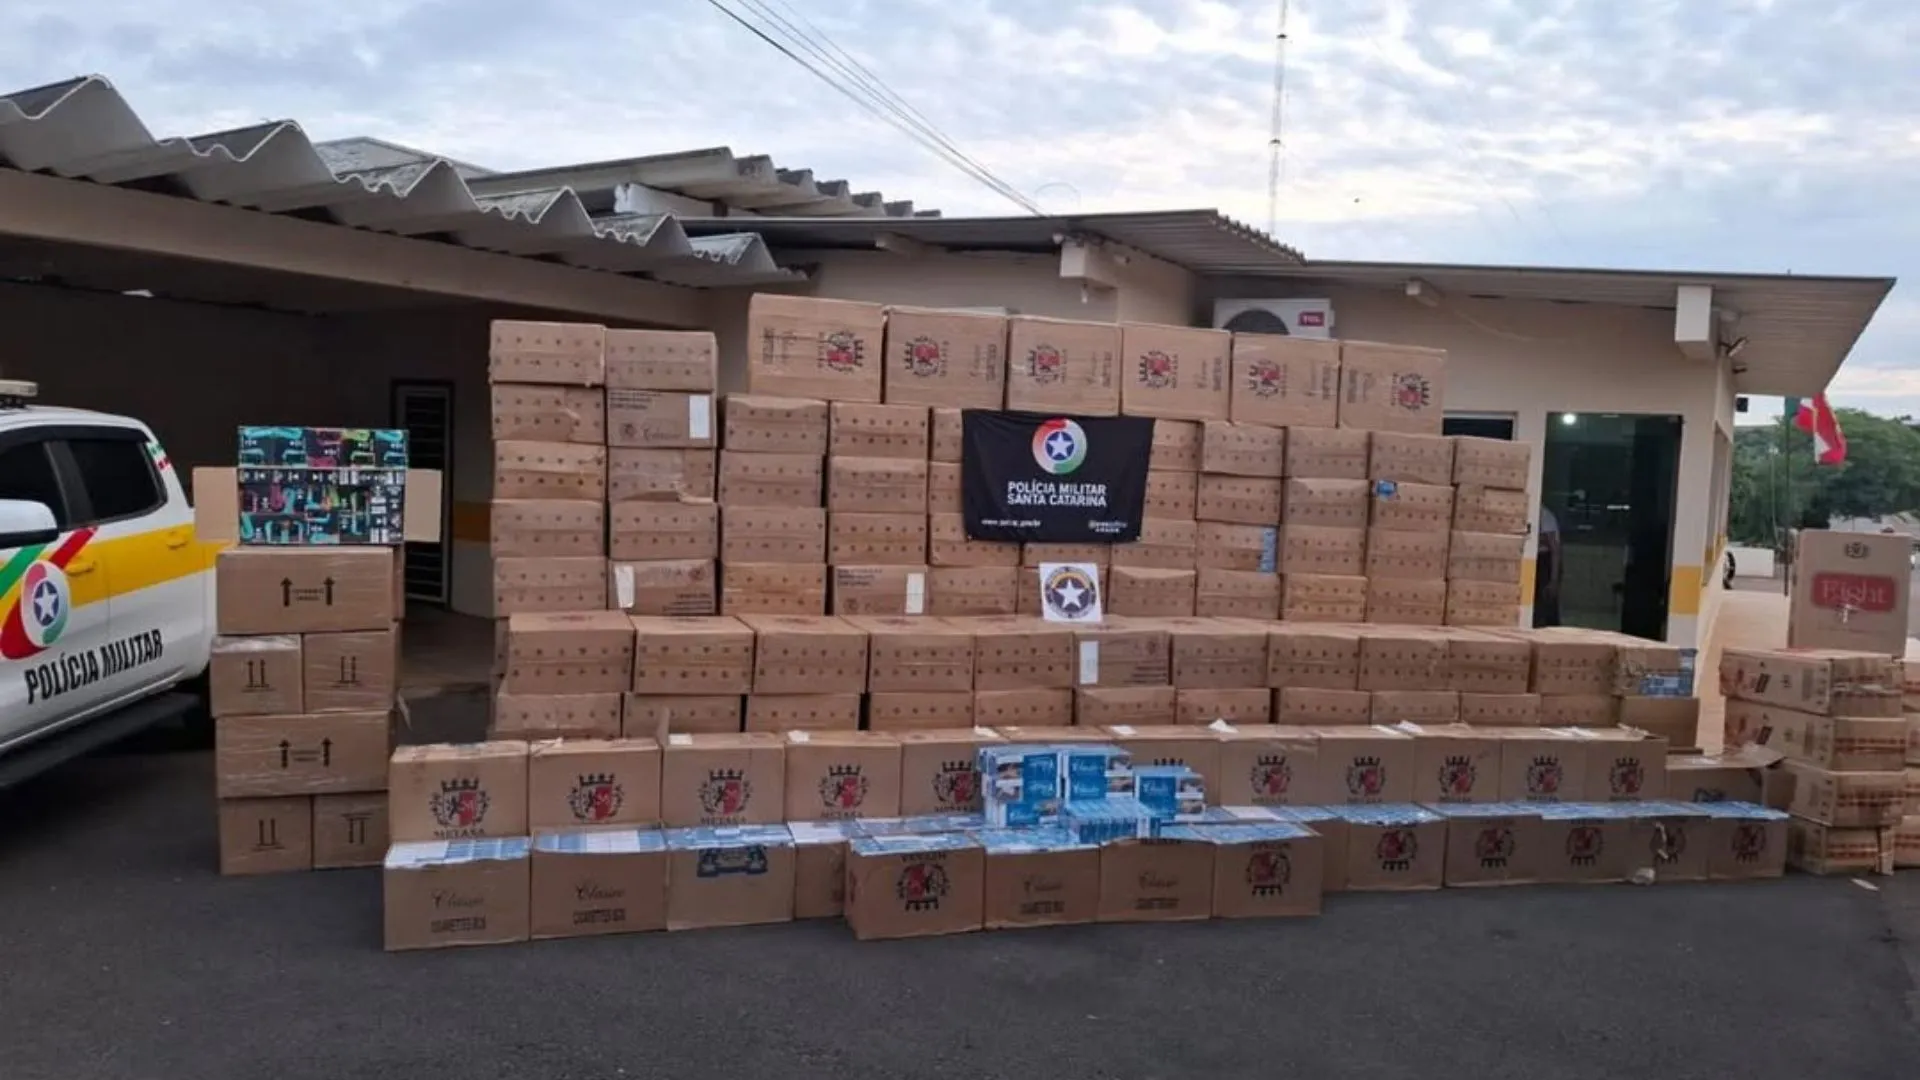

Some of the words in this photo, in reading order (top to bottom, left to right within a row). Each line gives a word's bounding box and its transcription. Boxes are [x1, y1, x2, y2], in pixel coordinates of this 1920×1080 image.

[1007, 479, 1056, 495] POLÍCIA
[1059, 483, 1107, 496] MILITAR
[1007, 493, 1047, 505] SANTA
[1050, 494, 1107, 507] CATARINA
[24, 650, 99, 704] POLÍCIA
[100, 628, 163, 678] MILITAR
